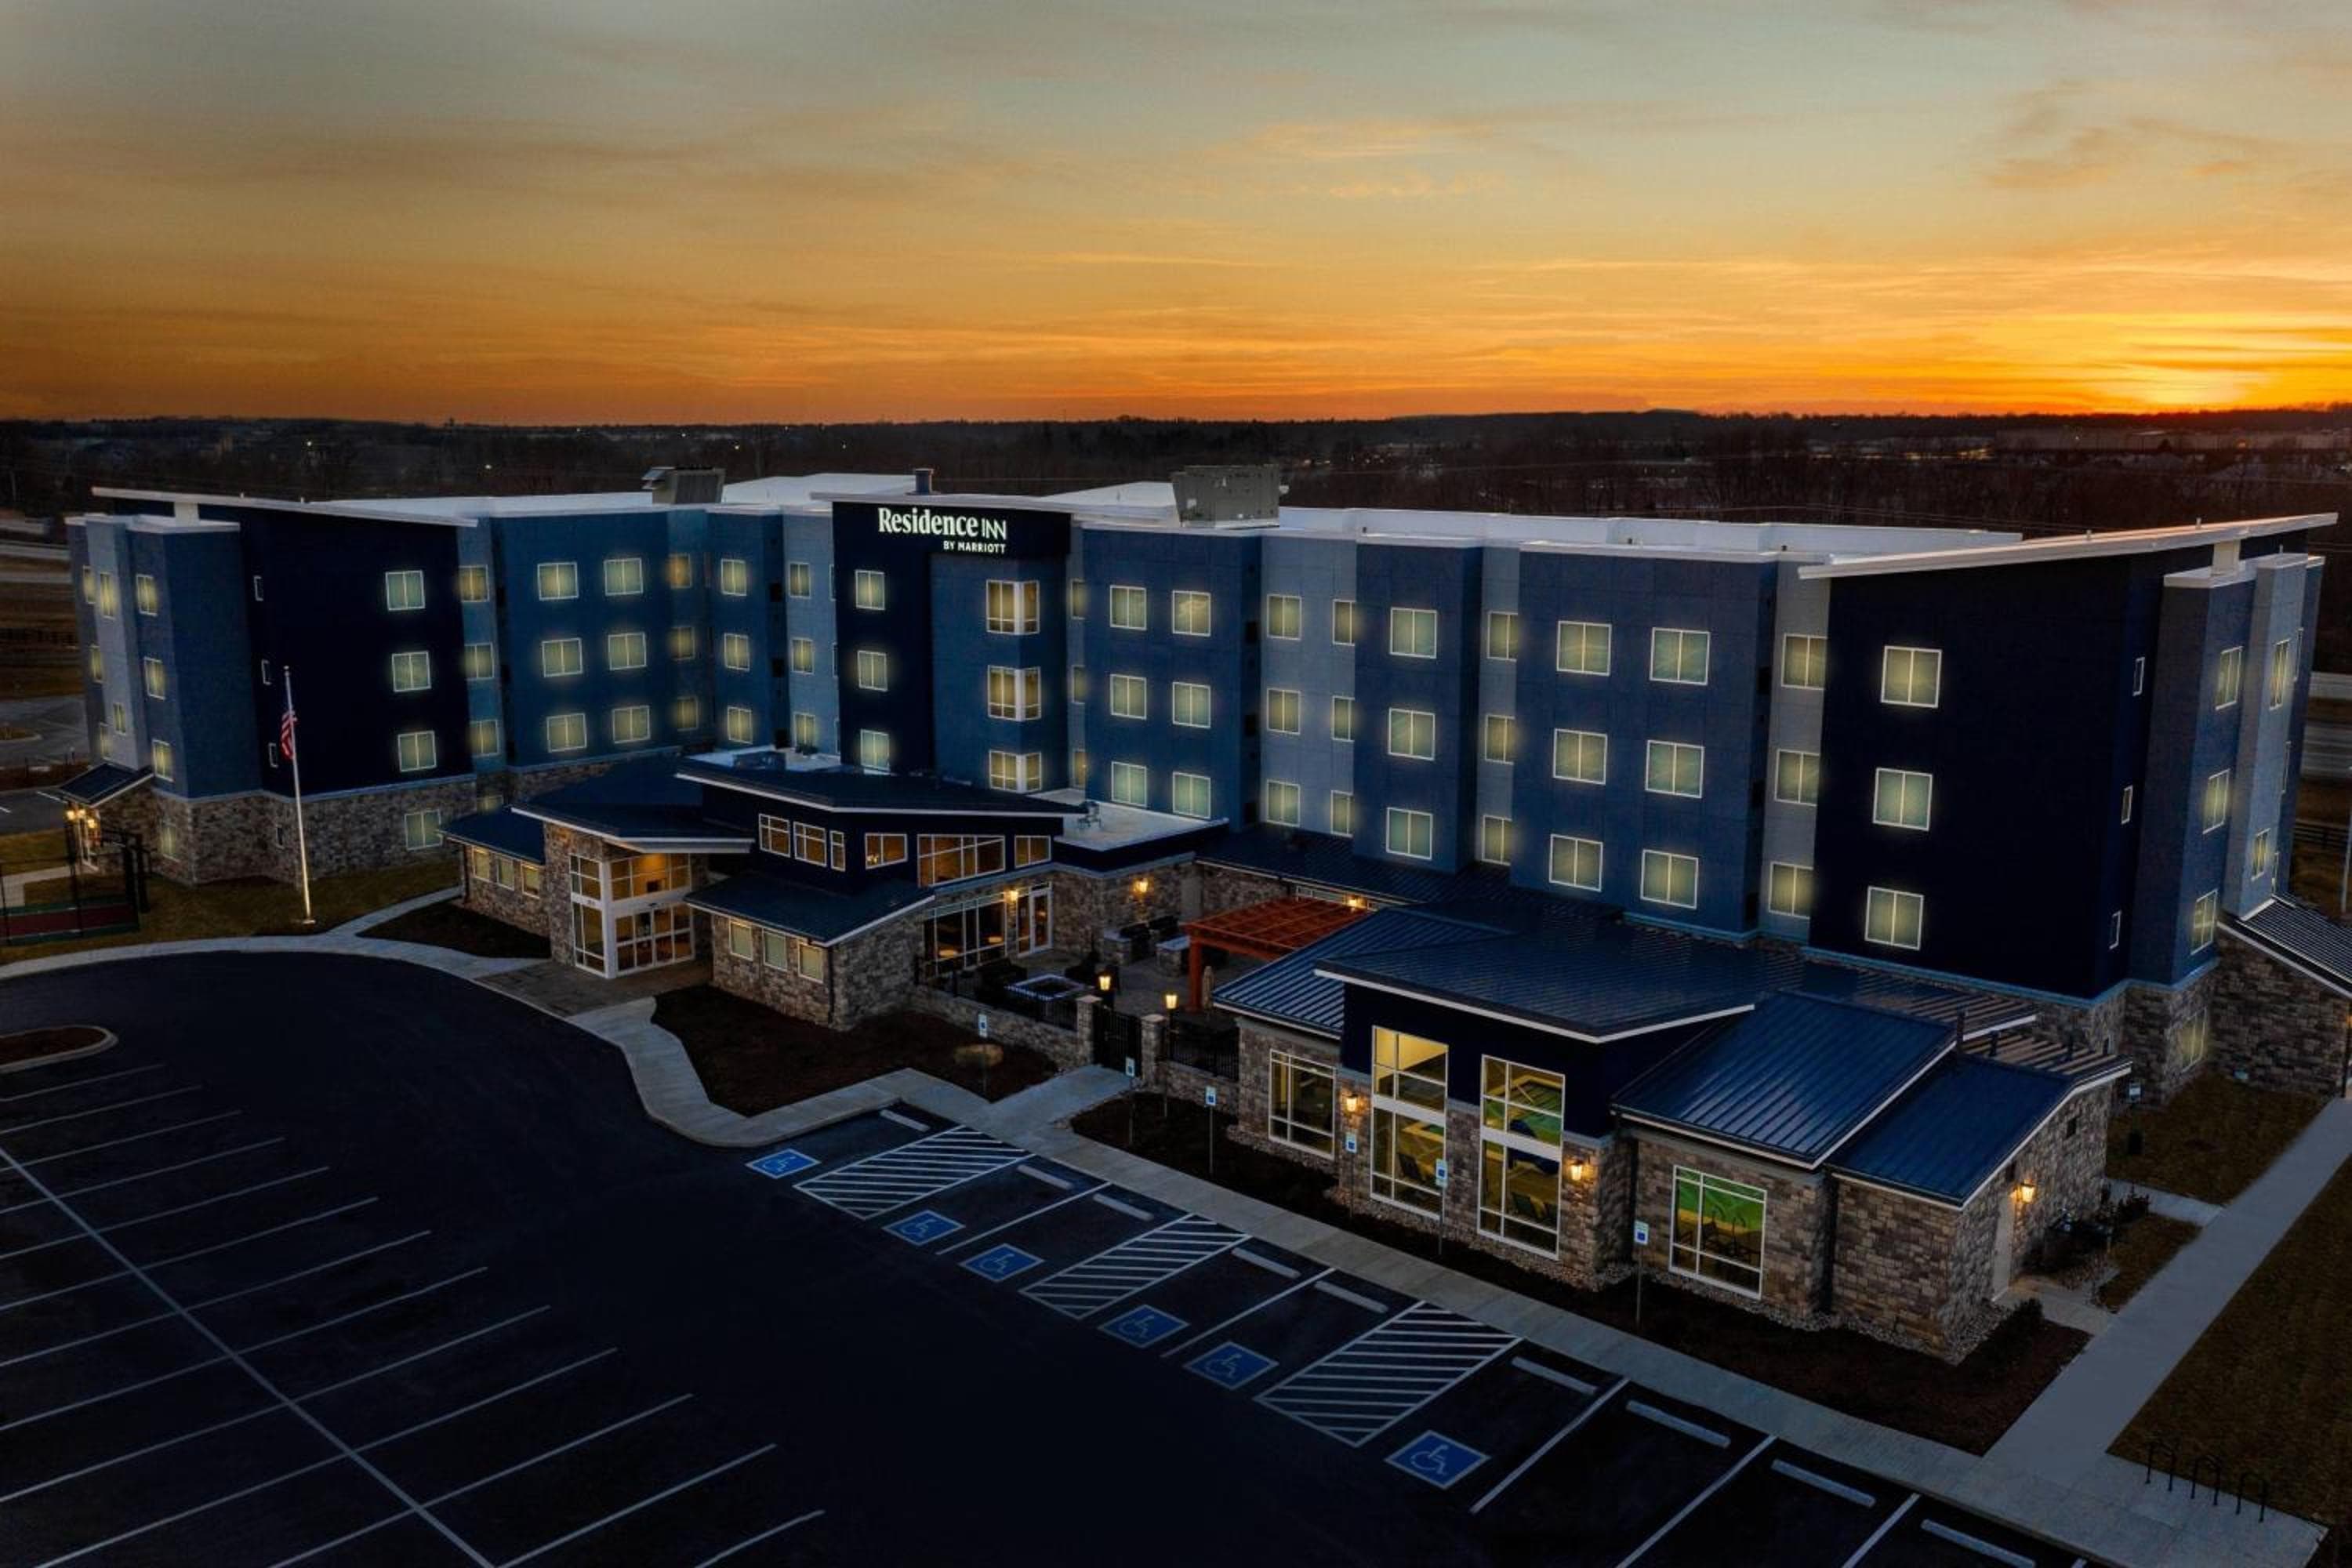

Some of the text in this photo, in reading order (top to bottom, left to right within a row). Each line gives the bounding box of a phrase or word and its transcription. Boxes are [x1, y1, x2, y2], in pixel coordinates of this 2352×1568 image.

[878, 507, 1007, 539] Residence INN
[943, 540, 1006, 554] BY MARRIOTT
